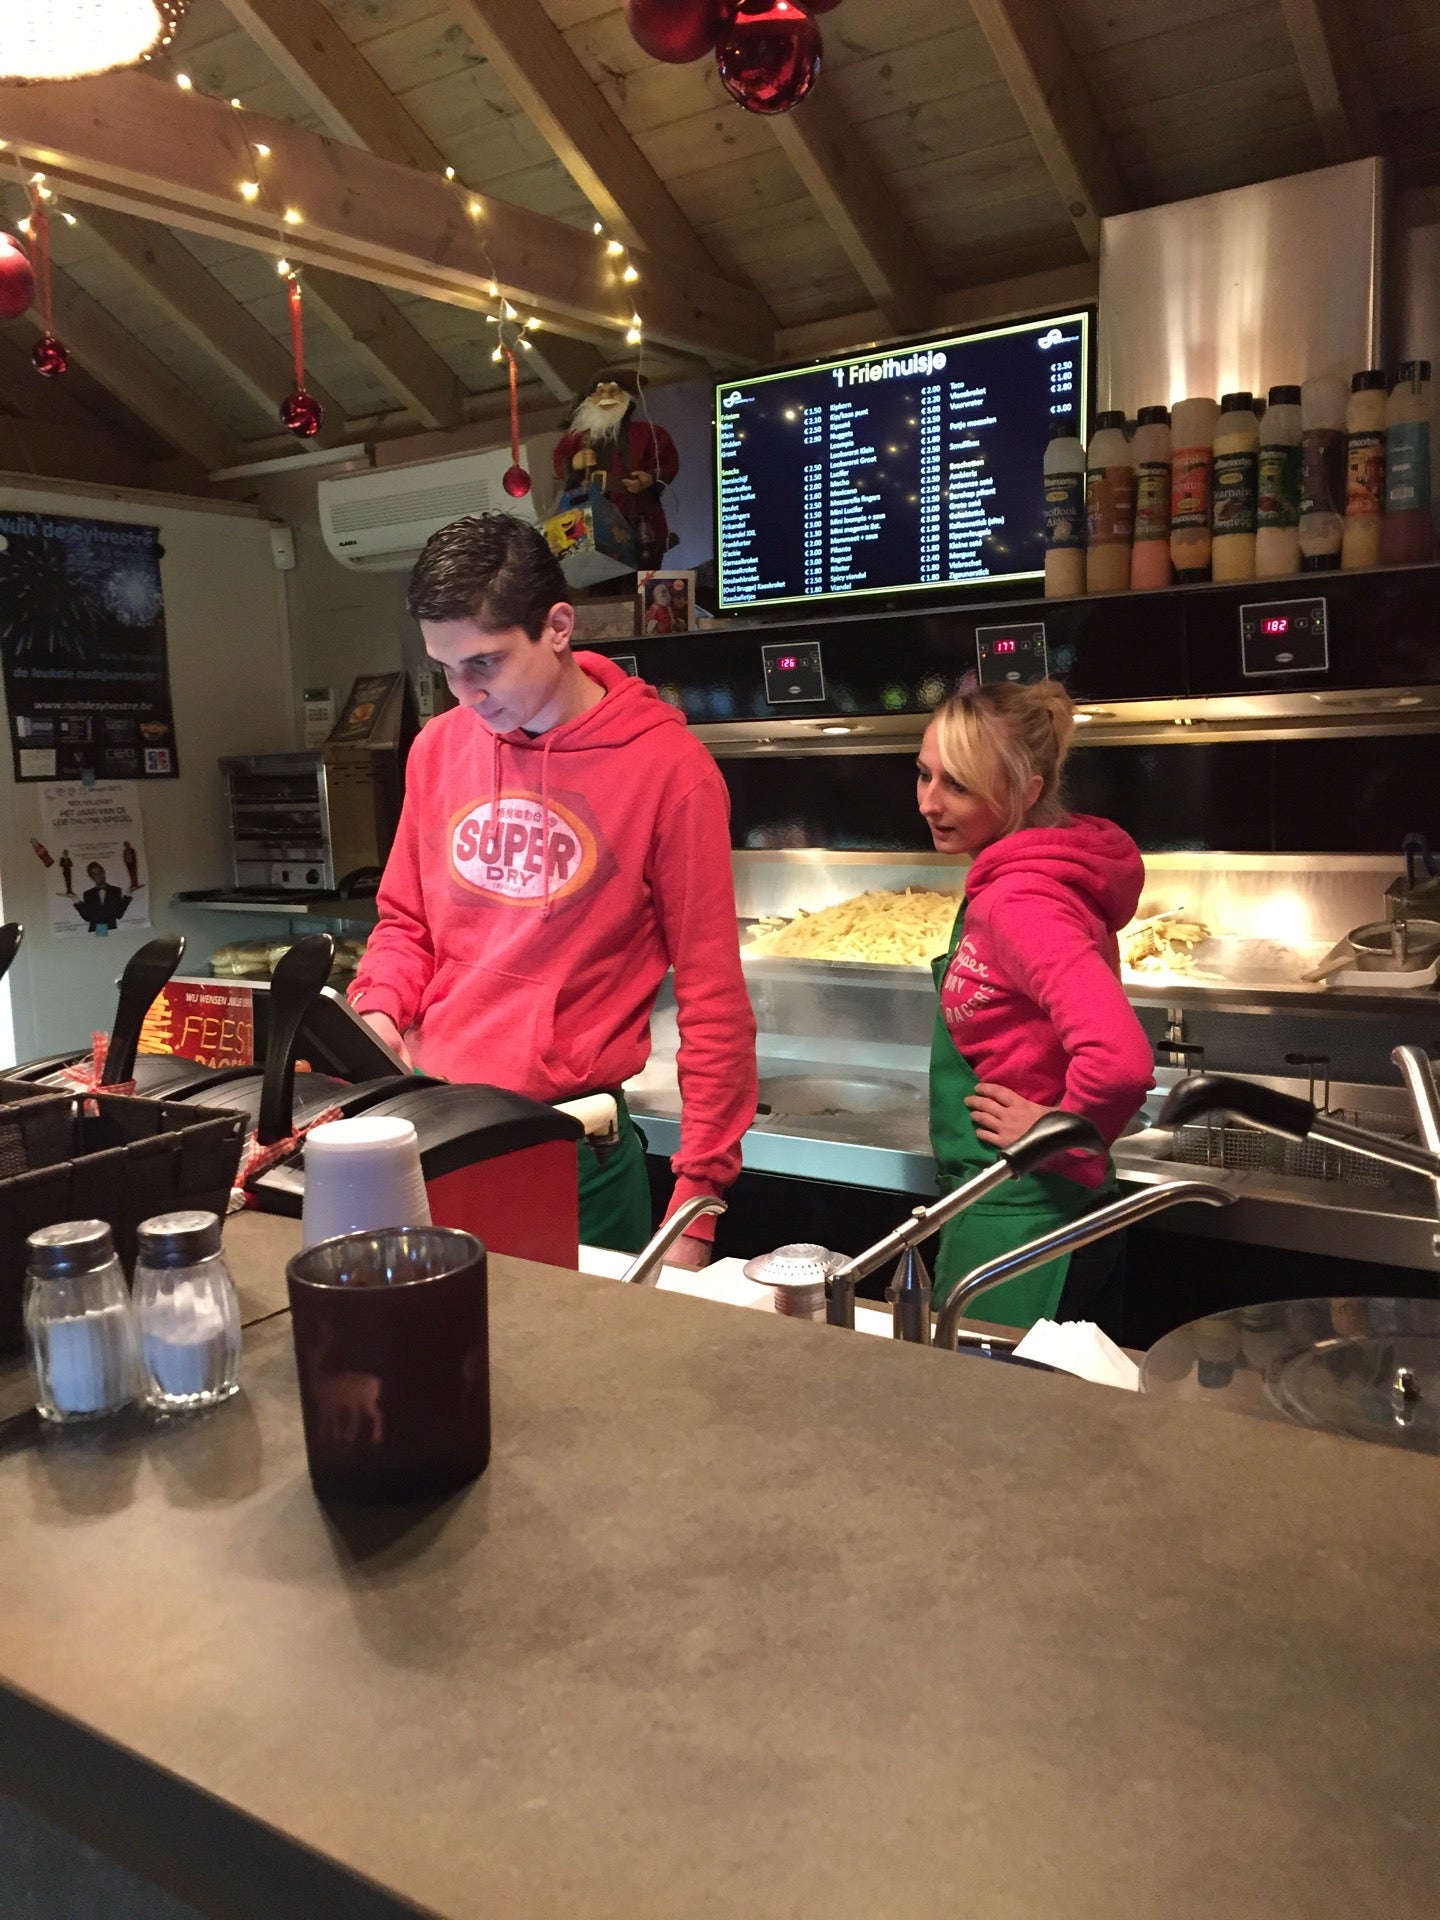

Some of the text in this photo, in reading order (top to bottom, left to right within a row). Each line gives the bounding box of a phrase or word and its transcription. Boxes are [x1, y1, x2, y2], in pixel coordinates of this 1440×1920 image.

[850, 350, 946, 385] Friethuisje
[860, 456, 877, 464] Groot
[1267, 620, 1286, 632] 182
[998, 641, 1014, 651] 177
[781, 658, 795, 668] 126
[456, 818, 575, 880] SUPER
[486, 866, 535, 886] DRY
[200, 994, 227, 1006] WENSEN
